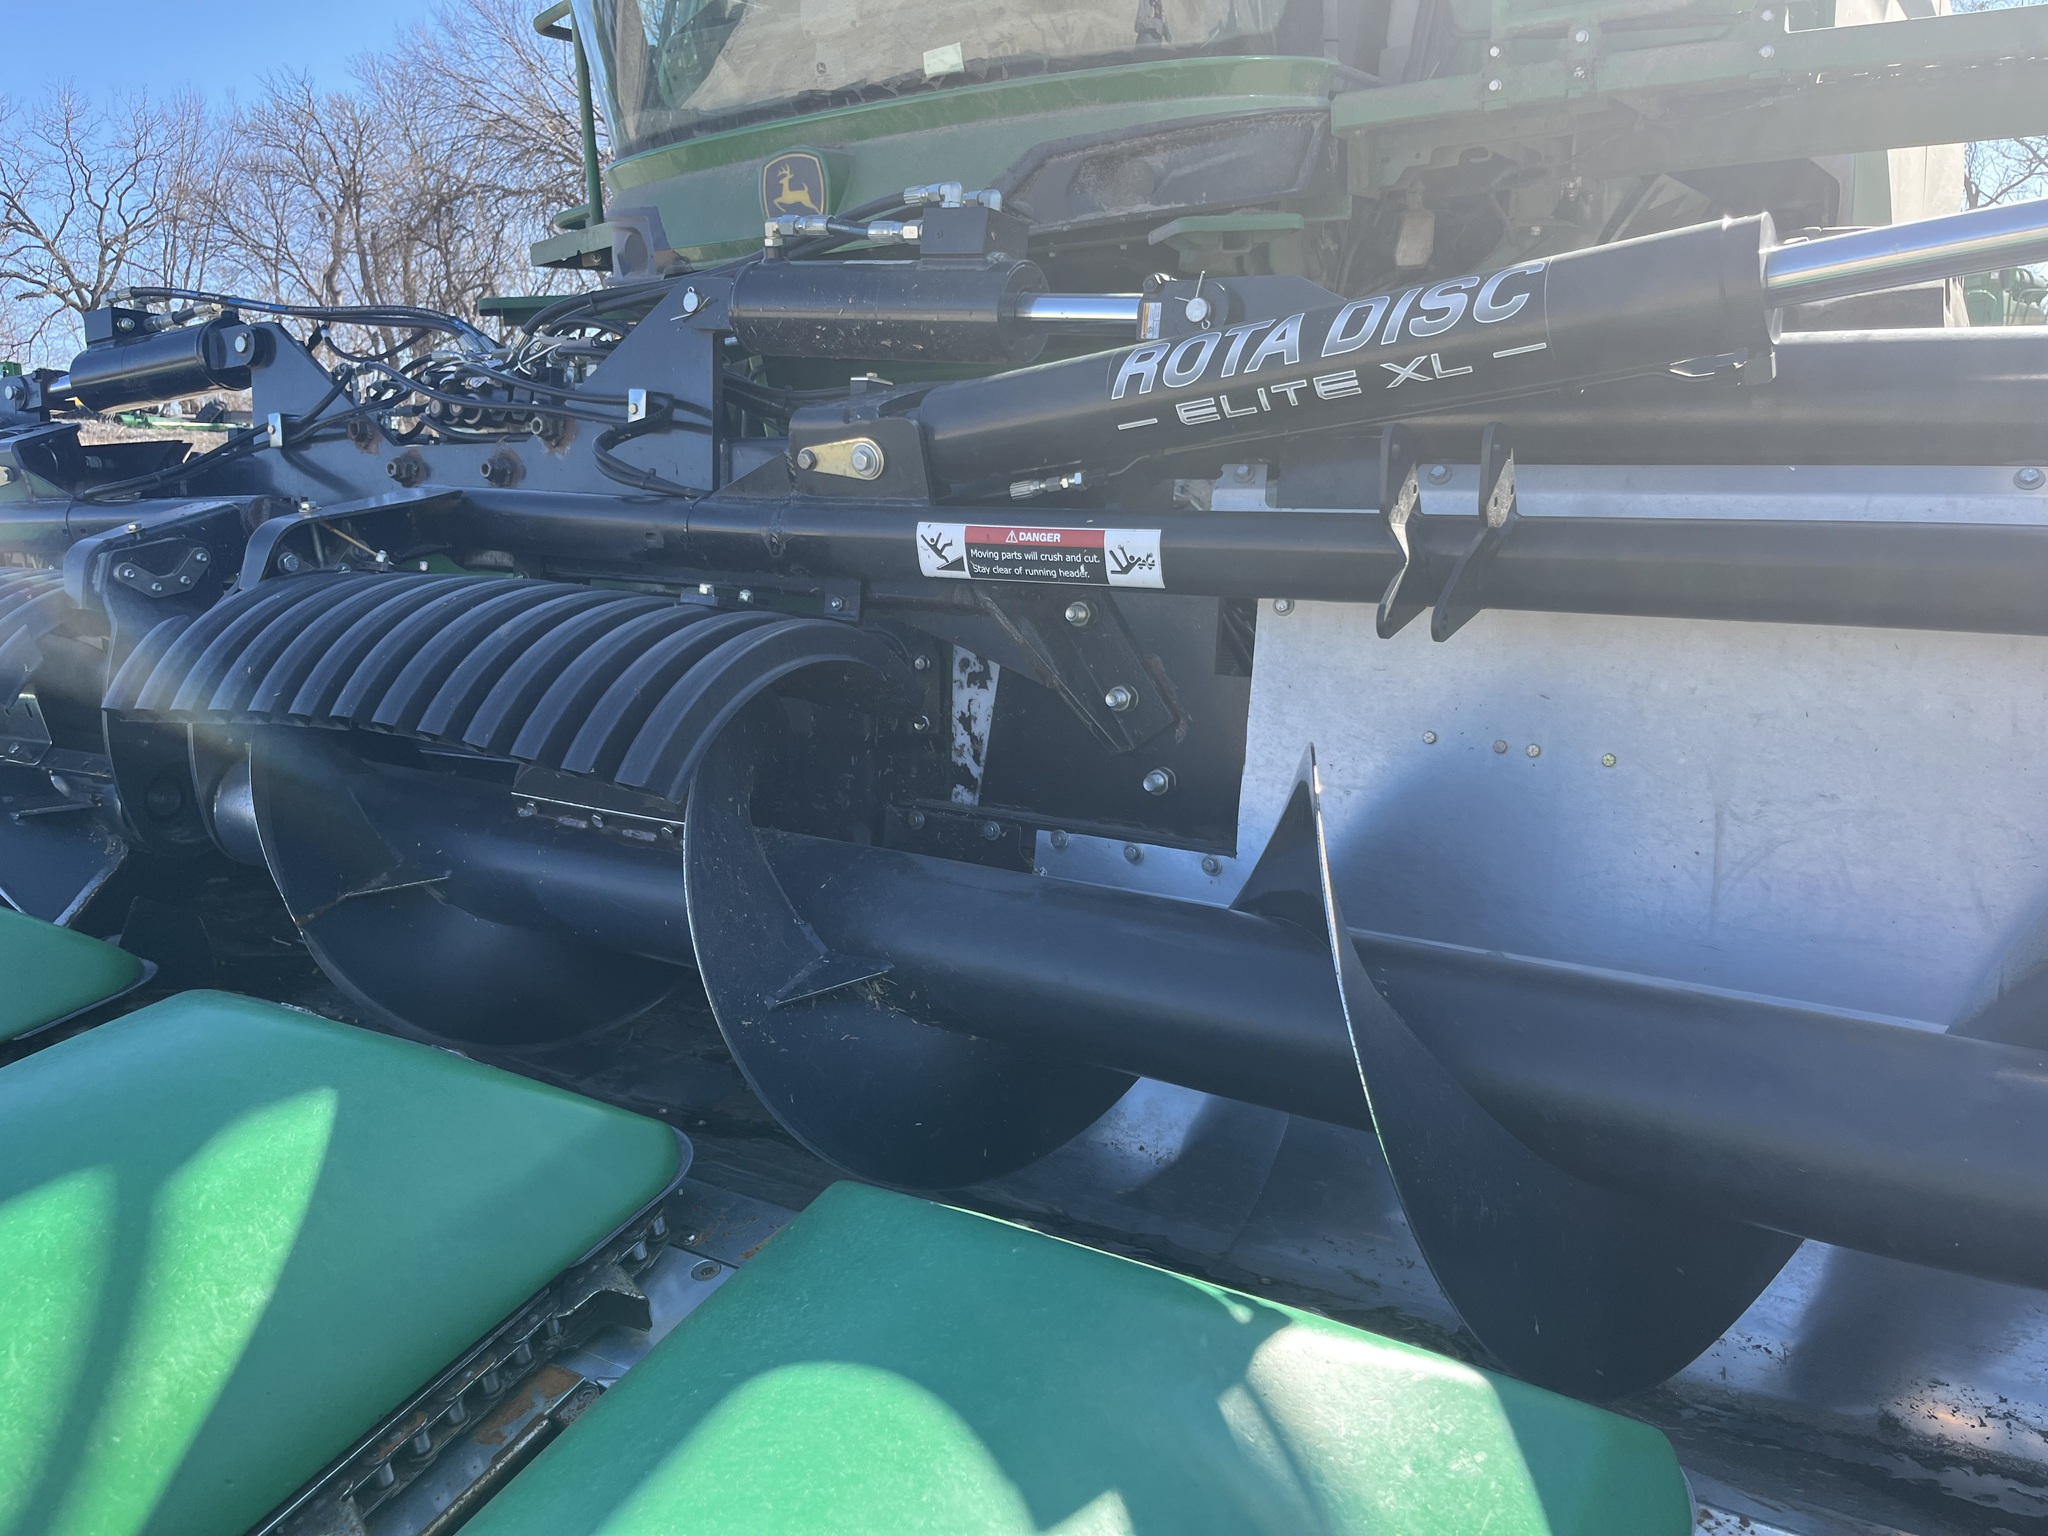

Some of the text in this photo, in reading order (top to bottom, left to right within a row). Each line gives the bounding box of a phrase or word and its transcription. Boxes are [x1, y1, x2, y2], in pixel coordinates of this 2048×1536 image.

[1111, 261, 1546, 400] ROTA DISC
[1175, 353, 1473, 426] ELITE XL
[1019, 532, 1061, 543] DANGER
[970, 548, 1101, 563] Moving parts will crush and cut.
[972, 564, 1091, 579] Stay clear of running header.
